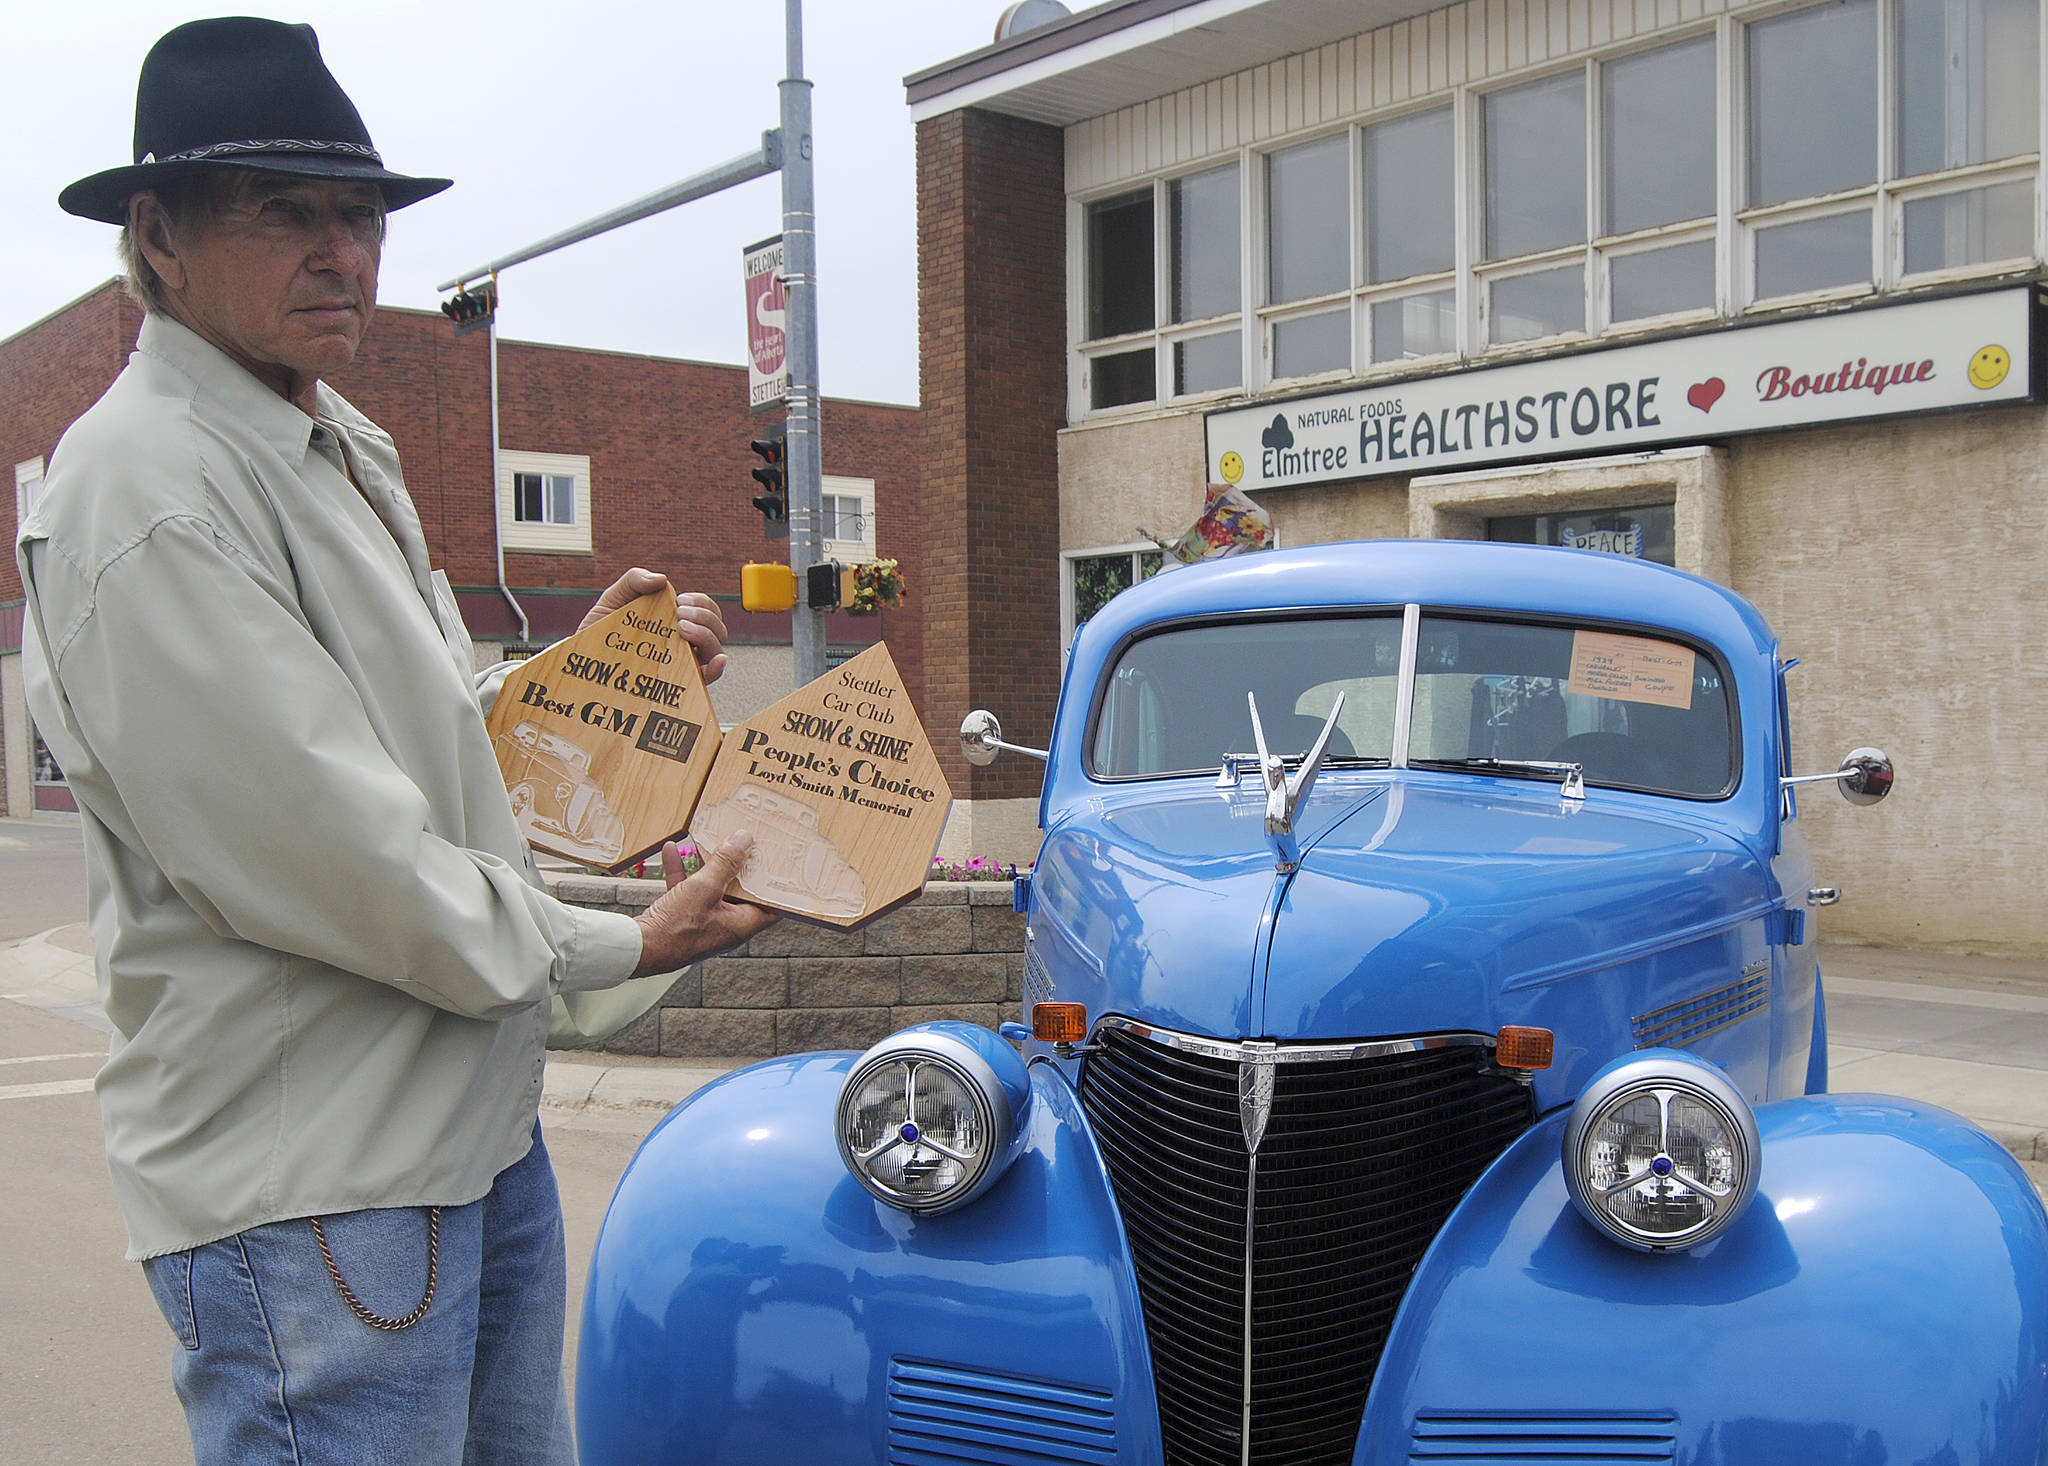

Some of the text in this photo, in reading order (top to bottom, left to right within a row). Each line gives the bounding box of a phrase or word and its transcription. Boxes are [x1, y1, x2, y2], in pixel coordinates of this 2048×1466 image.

[747, 248, 784, 277] WELCOME
[1756, 357, 1938, 403] Boutique
[1261, 376, 1662, 480] Elmtree HEALTHSTORE
[1298, 398, 1404, 429] NATURAL FOODS
[1575, 532, 1634, 555] PEACE
[621, 609, 678, 640] Stettler
[604, 631, 674, 666] Car Club
[561, 651, 687, 709] SHOW & SHINE
[838, 670, 897, 700] Stettler
[517, 679, 643, 738] Best GM
[822, 692, 896, 726] Car Club
[652, 718, 689, 749] GM
[781, 710, 914, 765] SHOW & SHINE
[737, 728, 936, 804] People's Choice
[746, 760, 914, 820] Loyd Smith Memorial
